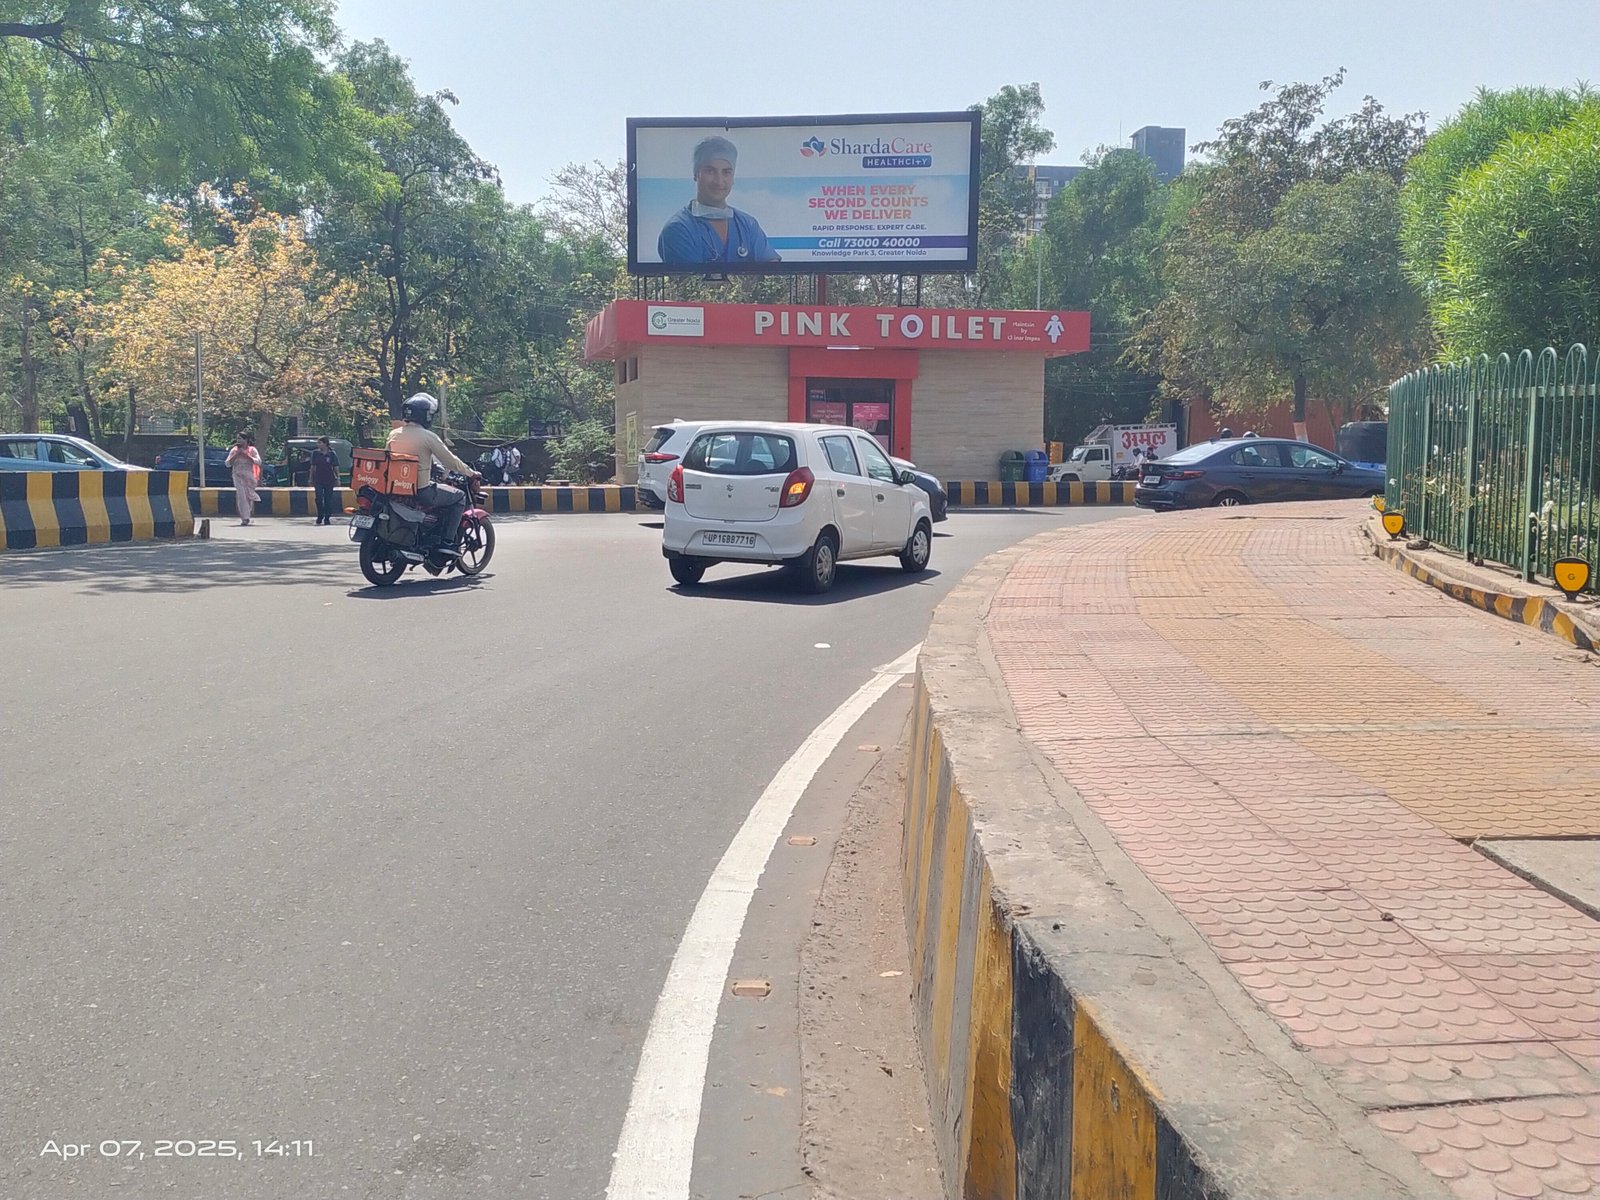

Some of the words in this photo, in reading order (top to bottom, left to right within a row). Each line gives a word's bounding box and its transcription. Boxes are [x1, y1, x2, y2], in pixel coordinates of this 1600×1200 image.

[830, 137, 933, 155] ShardaCare
[821, 185, 866, 196] WHEN
[869, 184, 916, 196] EVERY
[808, 197, 867, 208] SECOND
[870, 196, 929, 208] COUNTS
[824, 210, 848, 220] WE
[852, 209, 912, 220] DELIVER
[905, 223, 927, 231] CARE.
[818, 238, 841, 248] Call
[843, 238, 880, 248] 73000
[882, 237, 920, 248] 40000
[811, 249, 851, 257] Knowledge
[870, 249, 877, 257] 3,
[754, 310, 851, 337] PINK
[876, 313, 1007, 341] TOILET
[1020, 327, 1028, 335] by
[357, 473, 379, 485] Swiggy
[394, 479, 413, 489] Swiggy
